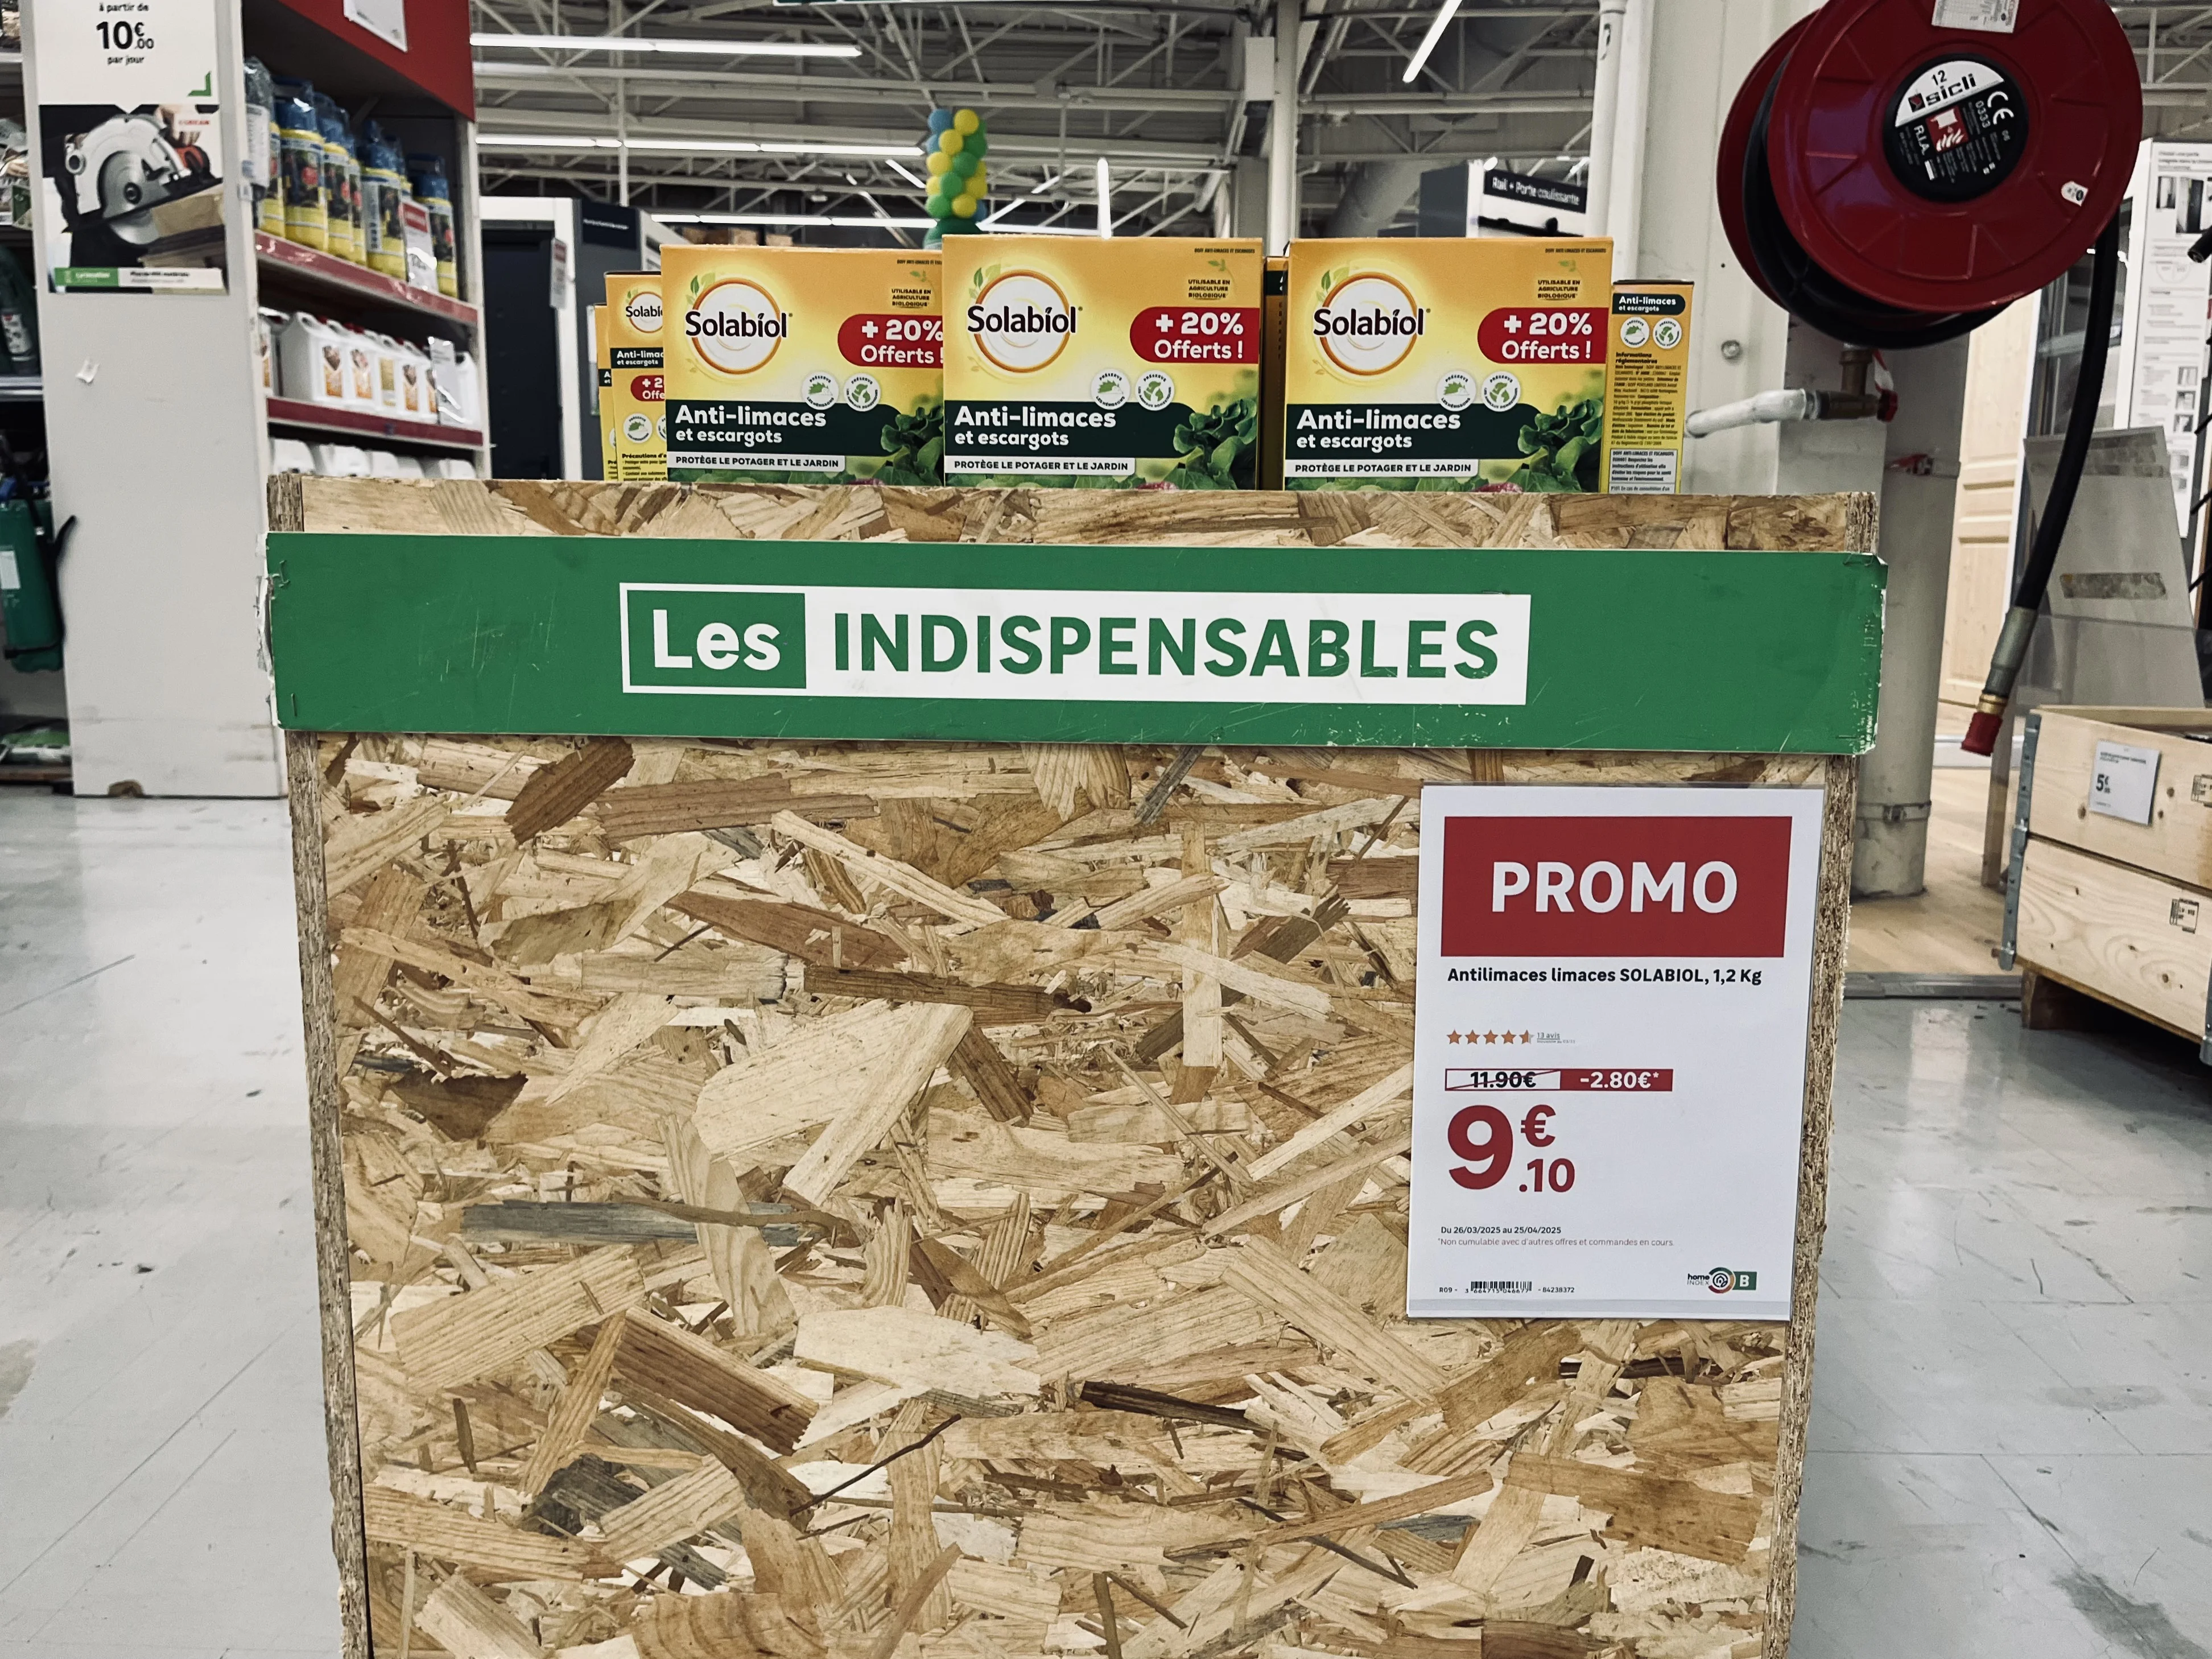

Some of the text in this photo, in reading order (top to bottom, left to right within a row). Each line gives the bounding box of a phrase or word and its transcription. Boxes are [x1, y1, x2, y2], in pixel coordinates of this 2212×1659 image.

[96, 21, 133, 49] 10
[108, 57, 123, 66] par
[1932, 70, 1947, 85] 12
[1925, 73, 1976, 106] sicli
[1492, 177, 1508, 191] Rail
[1516, 181, 1536, 197] Porte
[1538, 187, 1579, 205] coulissante
[1619, 296, 1676, 305] Anti-limaces
[626, 306, 663, 317] Solabi
[968, 306, 1077, 333] Solabiol
[685, 311, 788, 338] Solabiol
[886, 319, 943, 341] 20%
[1182, 312, 1244, 336] 20%
[1314, 308, 1423, 336] Solabiol
[1529, 313, 1592, 335] 20%
[861, 344, 934, 364] Offerts
[1154, 340, 1232, 359] Offerts
[1501, 341, 1580, 360] Offerts
[642, 390, 665, 399] Offe
[675, 405, 826, 427] Anti-limaces
[955, 406, 1116, 427] Anti-limaces
[1297, 410, 1461, 430] Anti-limaces
[676, 430, 782, 447] et escargots
[955, 432, 1069, 450] et escargots
[1297, 434, 1412, 453] et escargots
[676, 455, 717, 465] PROTÈGE
[733, 457, 775, 467] POTAGER
[803, 459, 839, 468] JARDIN
[955, 460, 999, 470] PROTÈGE
[1016, 462, 1061, 471] POTAGER
[1063, 462, 1075, 471] ET
[1077, 462, 1088, 471] LE
[1090, 462, 1128, 471] JARDIN
[1295, 463, 1340, 473] PROTÈGE
[1433, 464, 1471, 473] JARDIN
[653, 609, 1499, 679] Les INDISPENSABLES
[1491, 860, 1738, 913] PROMO
[1447, 968, 1762, 986] Antilimaces limaces SOLABIOL, 1,2 Kg
[1471, 1071, 1536, 1088] 11.90€
[1447, 1105, 1575, 1192] 9 € .10
[1740, 1275, 1749, 1287] B
